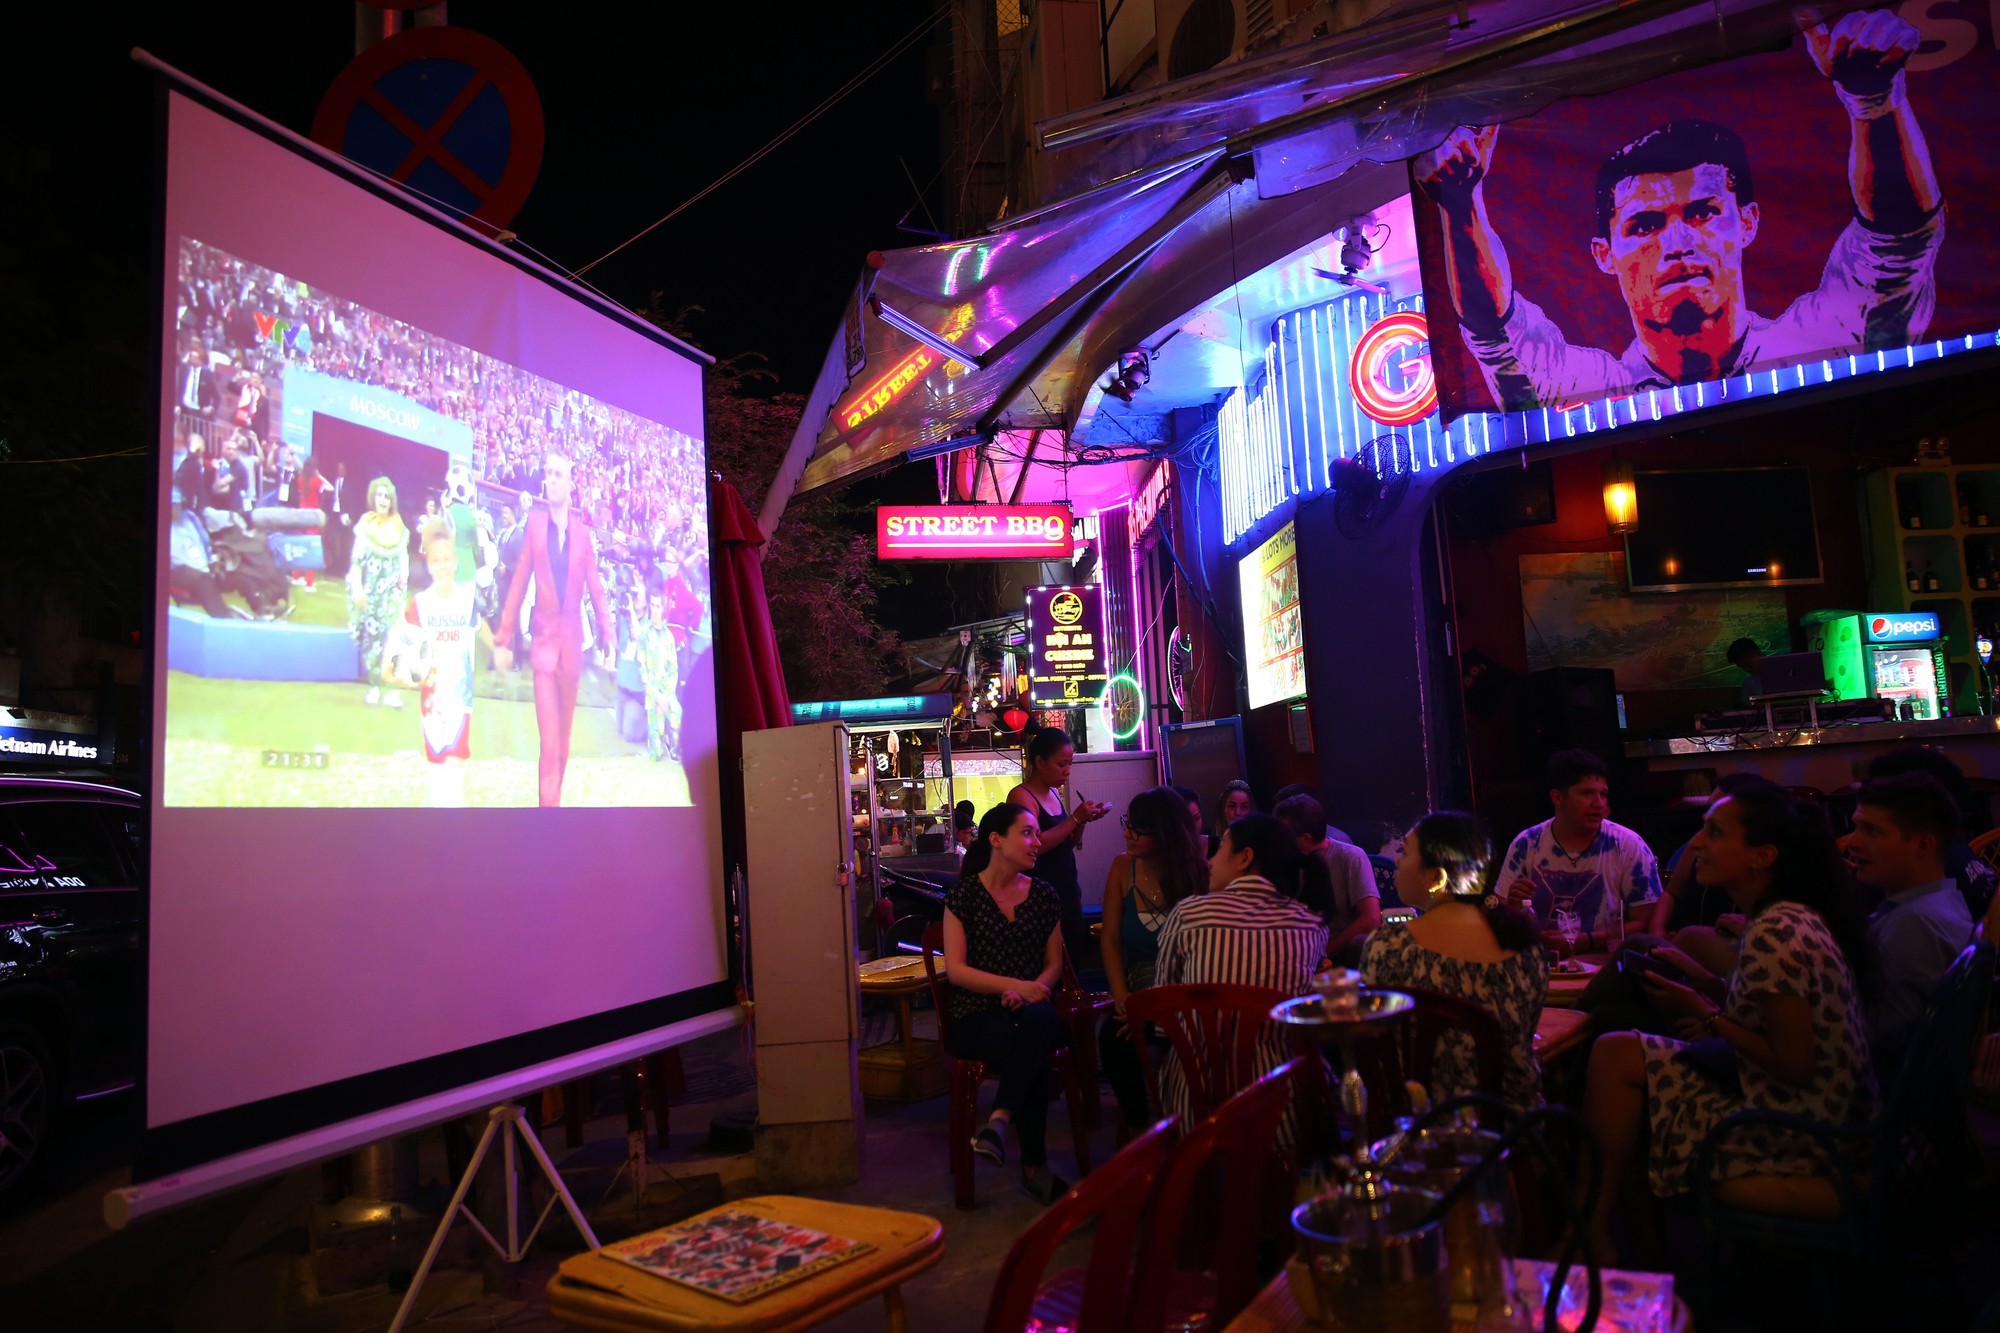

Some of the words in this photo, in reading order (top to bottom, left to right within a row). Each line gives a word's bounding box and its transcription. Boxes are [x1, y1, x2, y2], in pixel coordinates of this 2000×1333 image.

[350, 395, 420, 431] MOSCOW
[886, 515, 998, 537] STREET
[1006, 515, 1065, 541] BBQ
[1265, 538, 1279, 561] LOTS
[1279, 526, 1296, 551] MORE
[427, 614, 467, 628] RUSSIA
[1893, 618, 1936, 636] pepsi
[435, 629, 461, 642] 2018
[1071, 633, 1093, 645] AN
[47, 740, 98, 759] Airlines
[267, 752, 323, 768] 21:31
